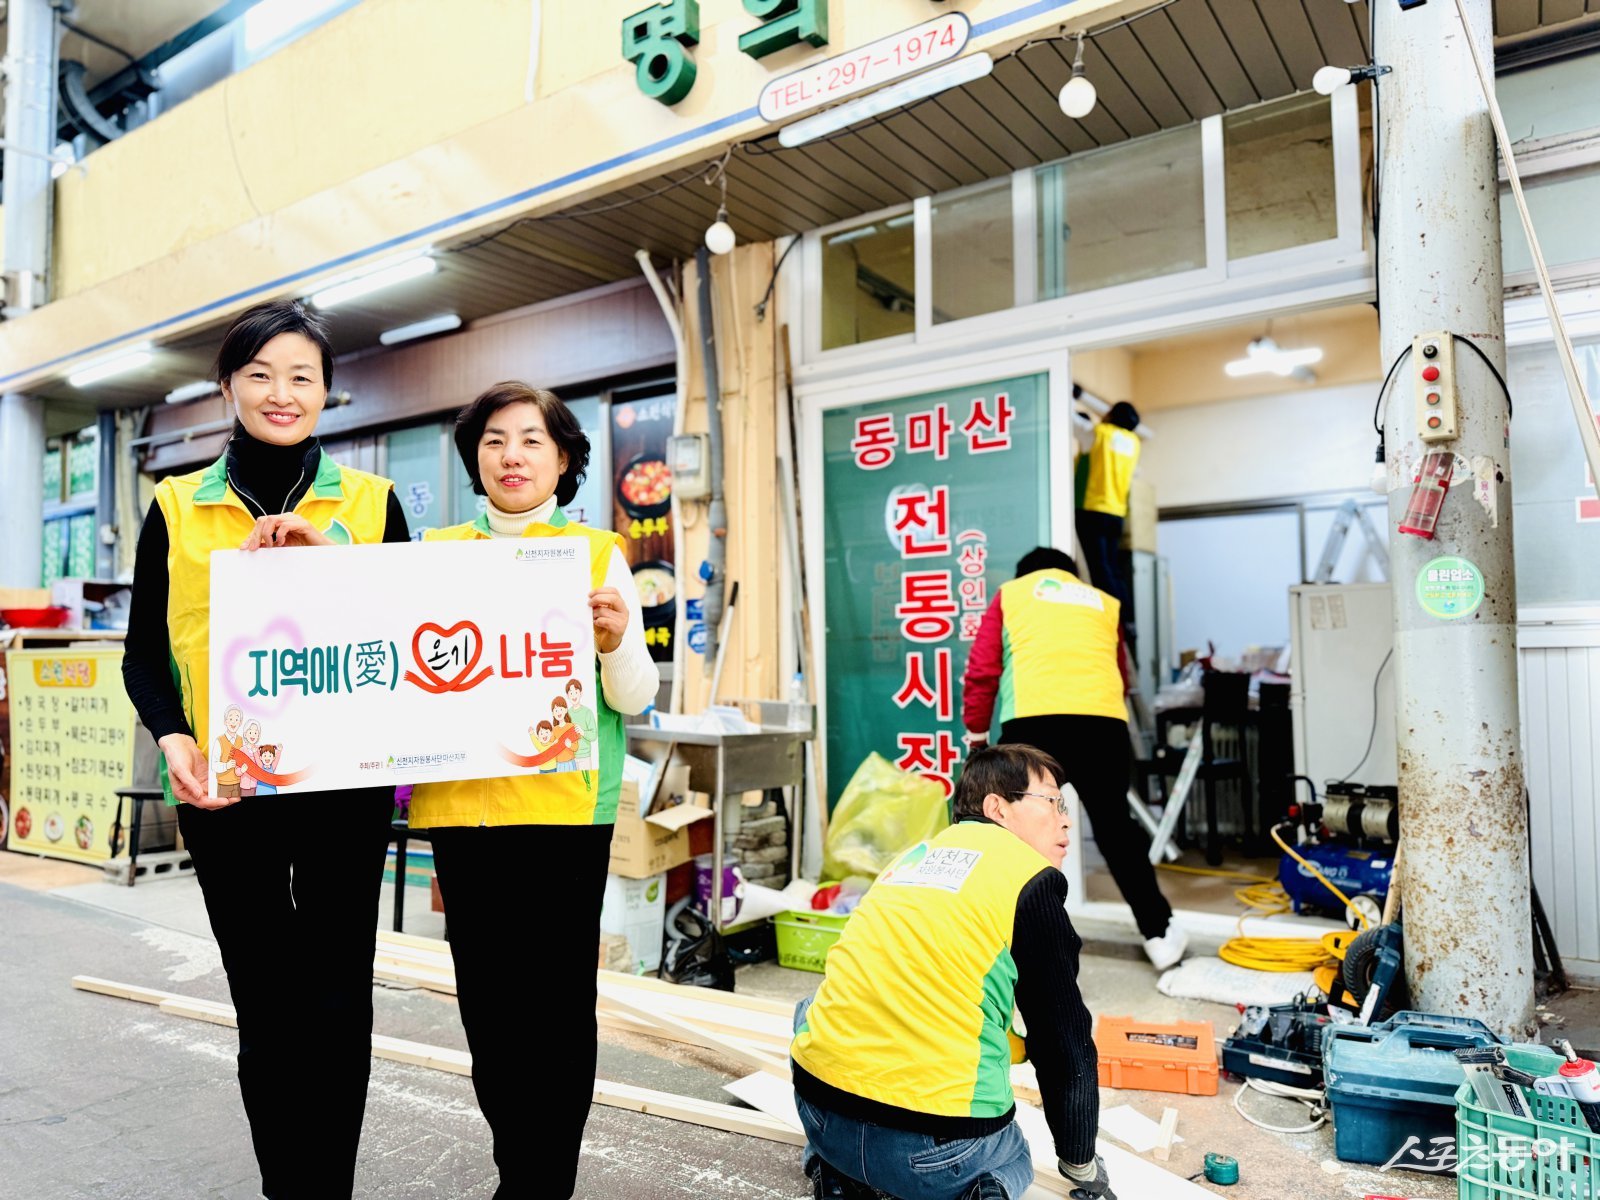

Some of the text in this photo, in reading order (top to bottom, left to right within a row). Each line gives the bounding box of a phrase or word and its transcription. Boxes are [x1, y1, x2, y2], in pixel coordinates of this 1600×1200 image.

[769, 23, 957, 110] TEL:297-1974
[853, 393, 1014, 469] 동마산
[524, 548, 575, 558] 신천지자원봉사단
[247, 631, 574, 697] 지역애(愛) 온기 나눔
[894, 486, 957, 799] 전통시장
[925, 849, 979, 869] 신천지
